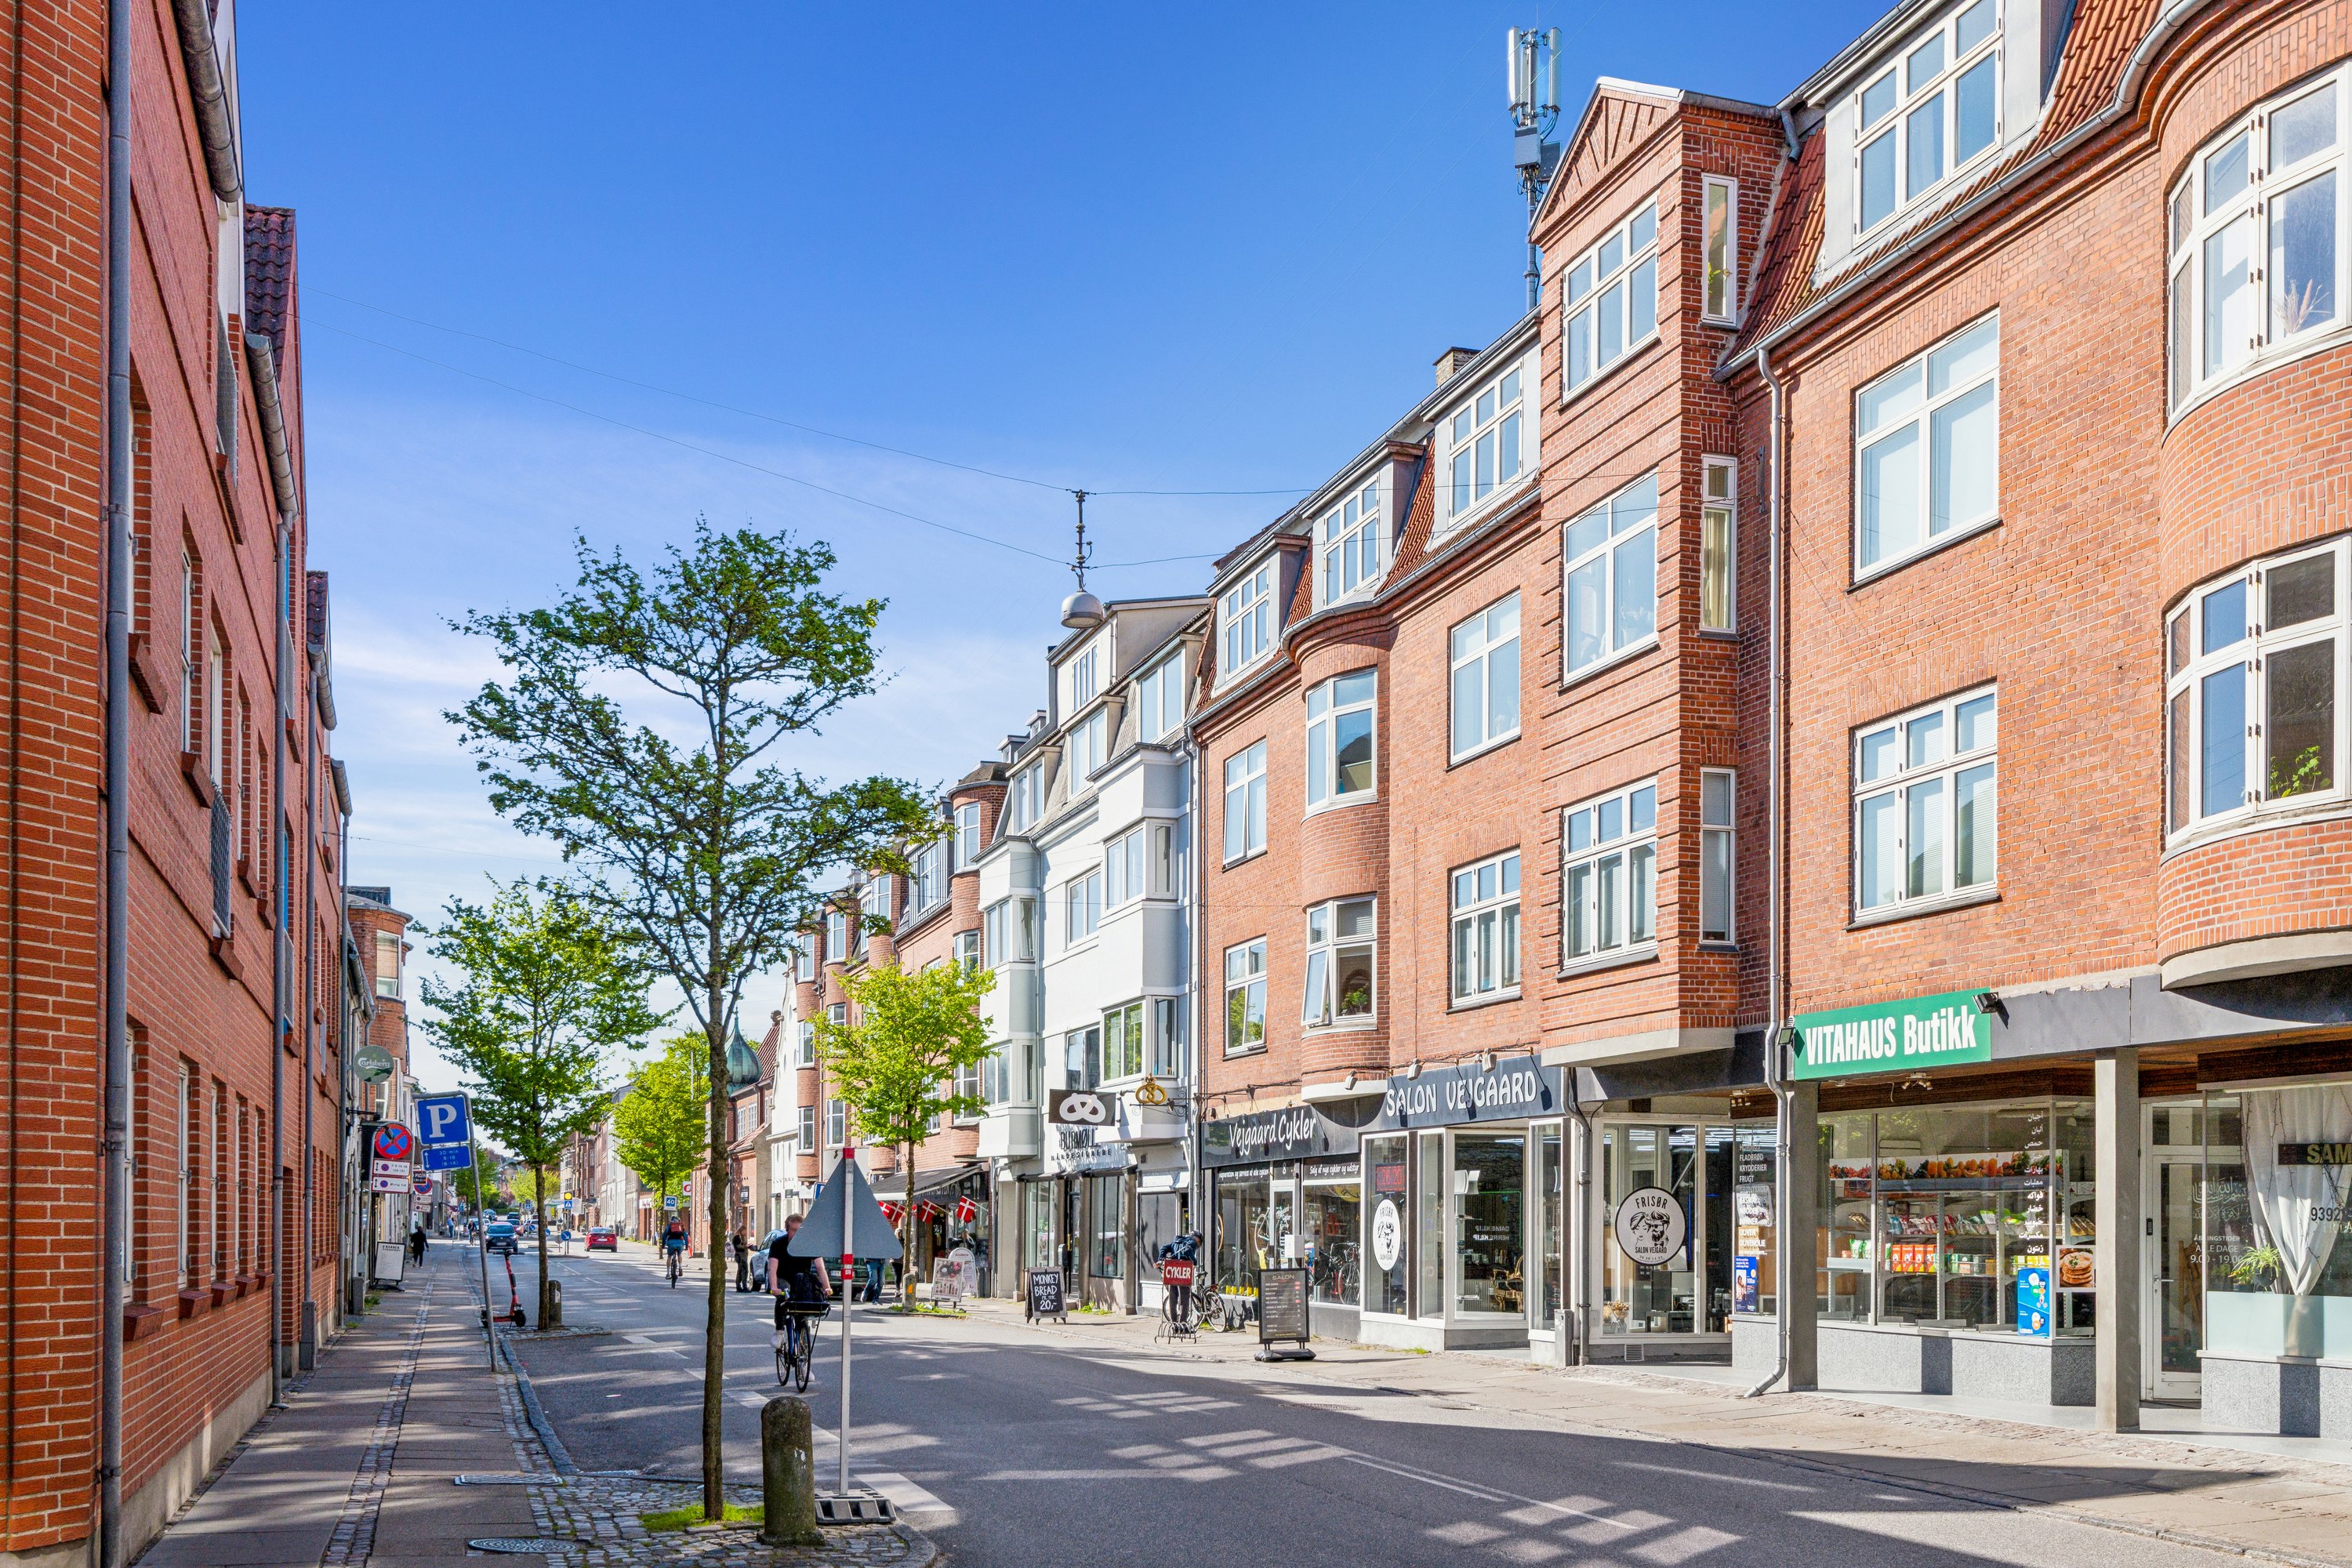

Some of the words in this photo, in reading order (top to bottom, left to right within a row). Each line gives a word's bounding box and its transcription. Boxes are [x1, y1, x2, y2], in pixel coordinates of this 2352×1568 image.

[1806, 1016, 1896, 1065] VITAHAUS
[1904, 1005, 1976, 1055] Butikk
[358, 1058, 390, 1068] Carlsberg
[1386, 1083, 1437, 1116] SALON
[1446, 1071, 1537, 1111] VEJGAARD
[426, 1104, 457, 1138] P
[1229, 1113, 1276, 1156] Vejgaard
[1278, 1109, 1316, 1150] Cykler
[1282, 1162, 1287, 1174] 8
[1309, 1165, 1318, 1176] Salg
[1318, 1164, 1323, 1174] af
[1329, 1163, 1341, 1176] cykler
[1341, 1165, 1346, 1175] og
[1346, 1162, 1359, 1174] udstyr
[1739, 1163, 1767, 1172] KRYDDERIER
[1739, 1174, 1754, 1183] FRUGT
[1635, 1196, 1668, 1209] FRISØR
[2194, 1233, 2241, 1242] ÅBINGSTIDER
[2216, 1244, 2239, 1253] DAGE
[1033, 1272, 1058, 1285] MONKEY
[1165, 1265, 1191, 1279] CYKLER
[1034, 1285, 1058, 1297] BREAD
